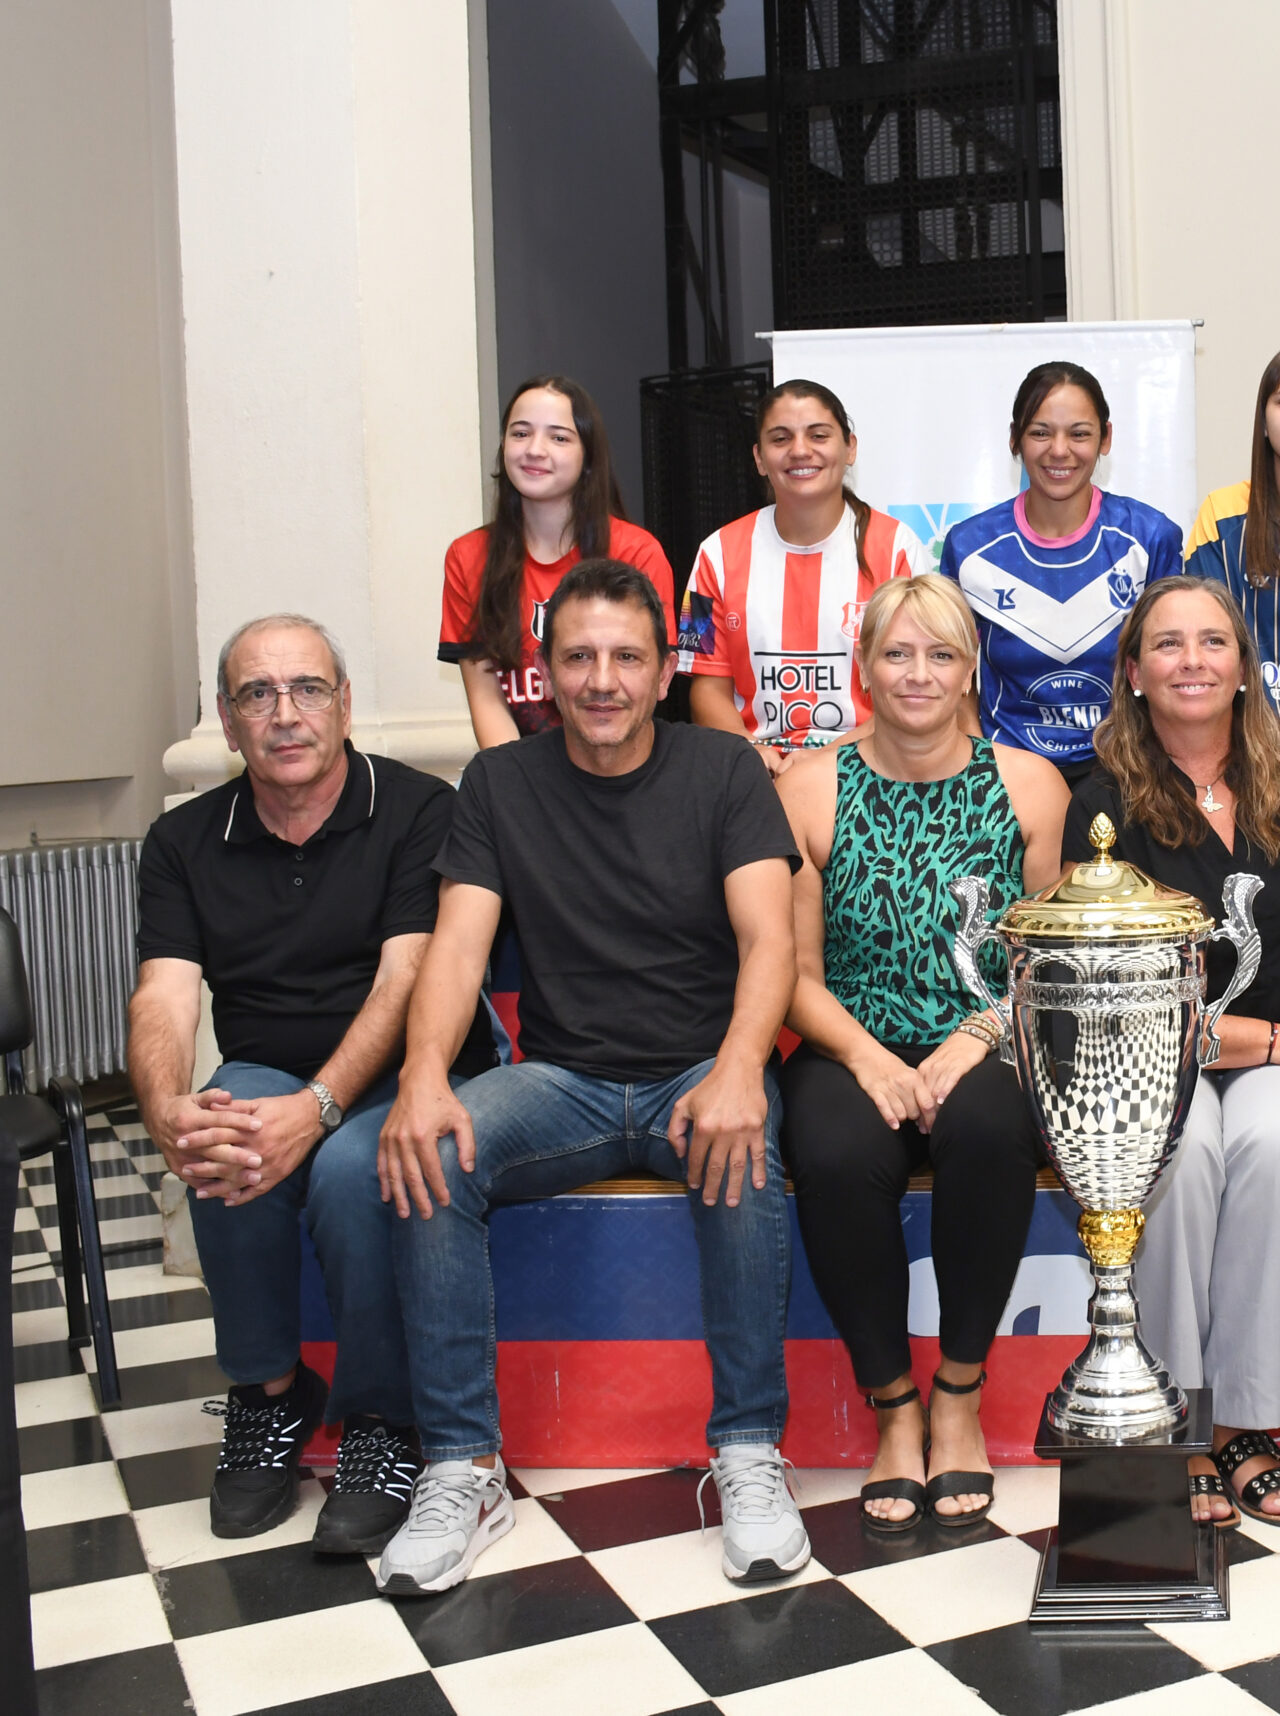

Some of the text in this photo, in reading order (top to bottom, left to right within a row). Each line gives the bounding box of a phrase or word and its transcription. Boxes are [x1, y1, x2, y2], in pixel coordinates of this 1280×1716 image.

[760, 665, 842, 691] HOTEL
[1050, 678, 1084, 689] WINE
[763, 701, 844, 733] PICO
[1038, 704, 1102, 729] BLEND
